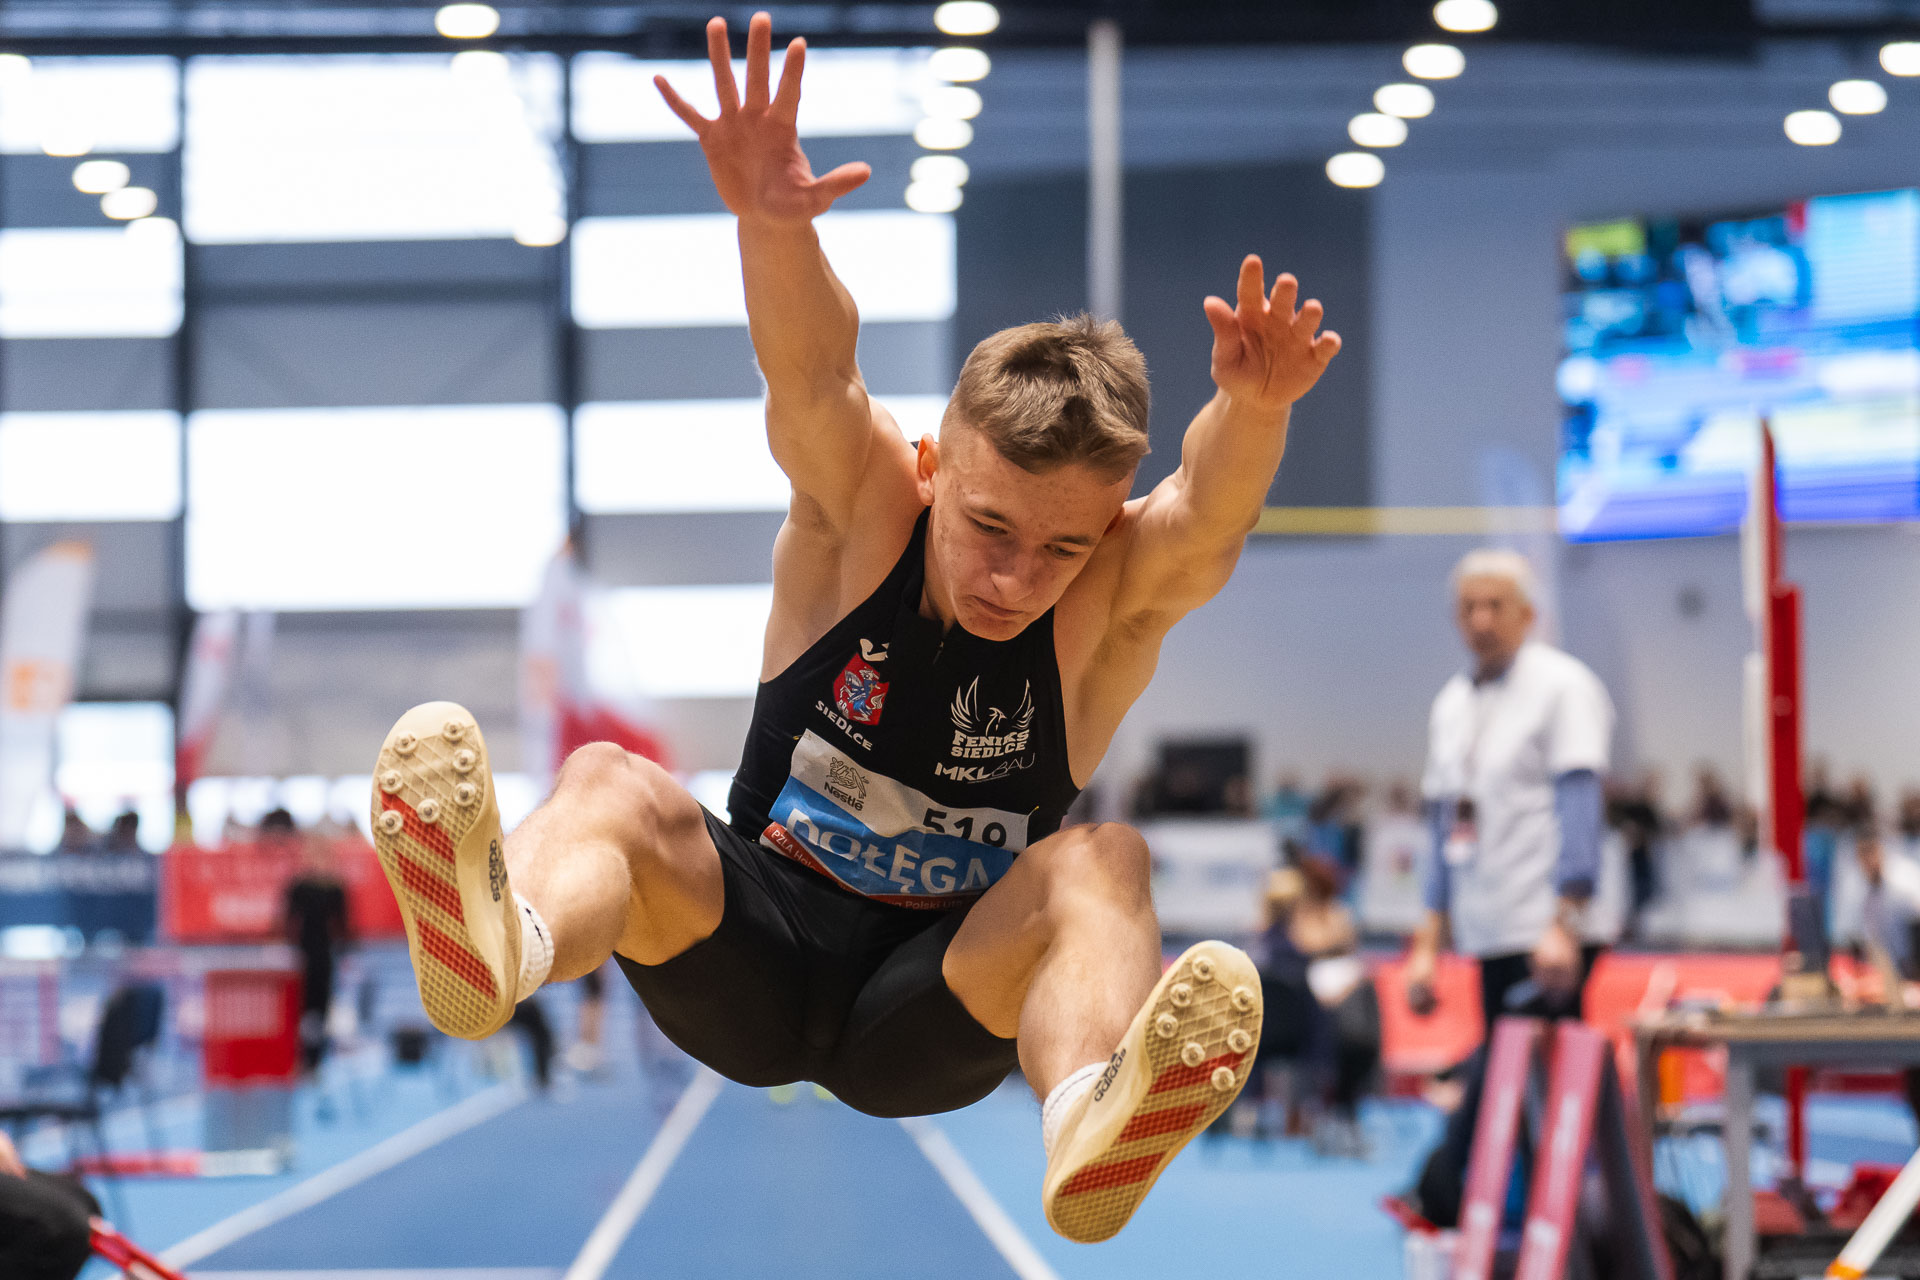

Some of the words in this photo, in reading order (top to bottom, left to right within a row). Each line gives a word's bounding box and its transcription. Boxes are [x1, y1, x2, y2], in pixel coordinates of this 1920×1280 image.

[815, 700, 873, 751] SIEDLCE
[952, 729, 1030, 748] FENIKS
[950, 741, 1027, 759] SIEDLCE
[771, 829, 794, 853] PZLA
[489, 839, 501, 902] adidas
[1094, 1048, 1126, 1102] adidas
